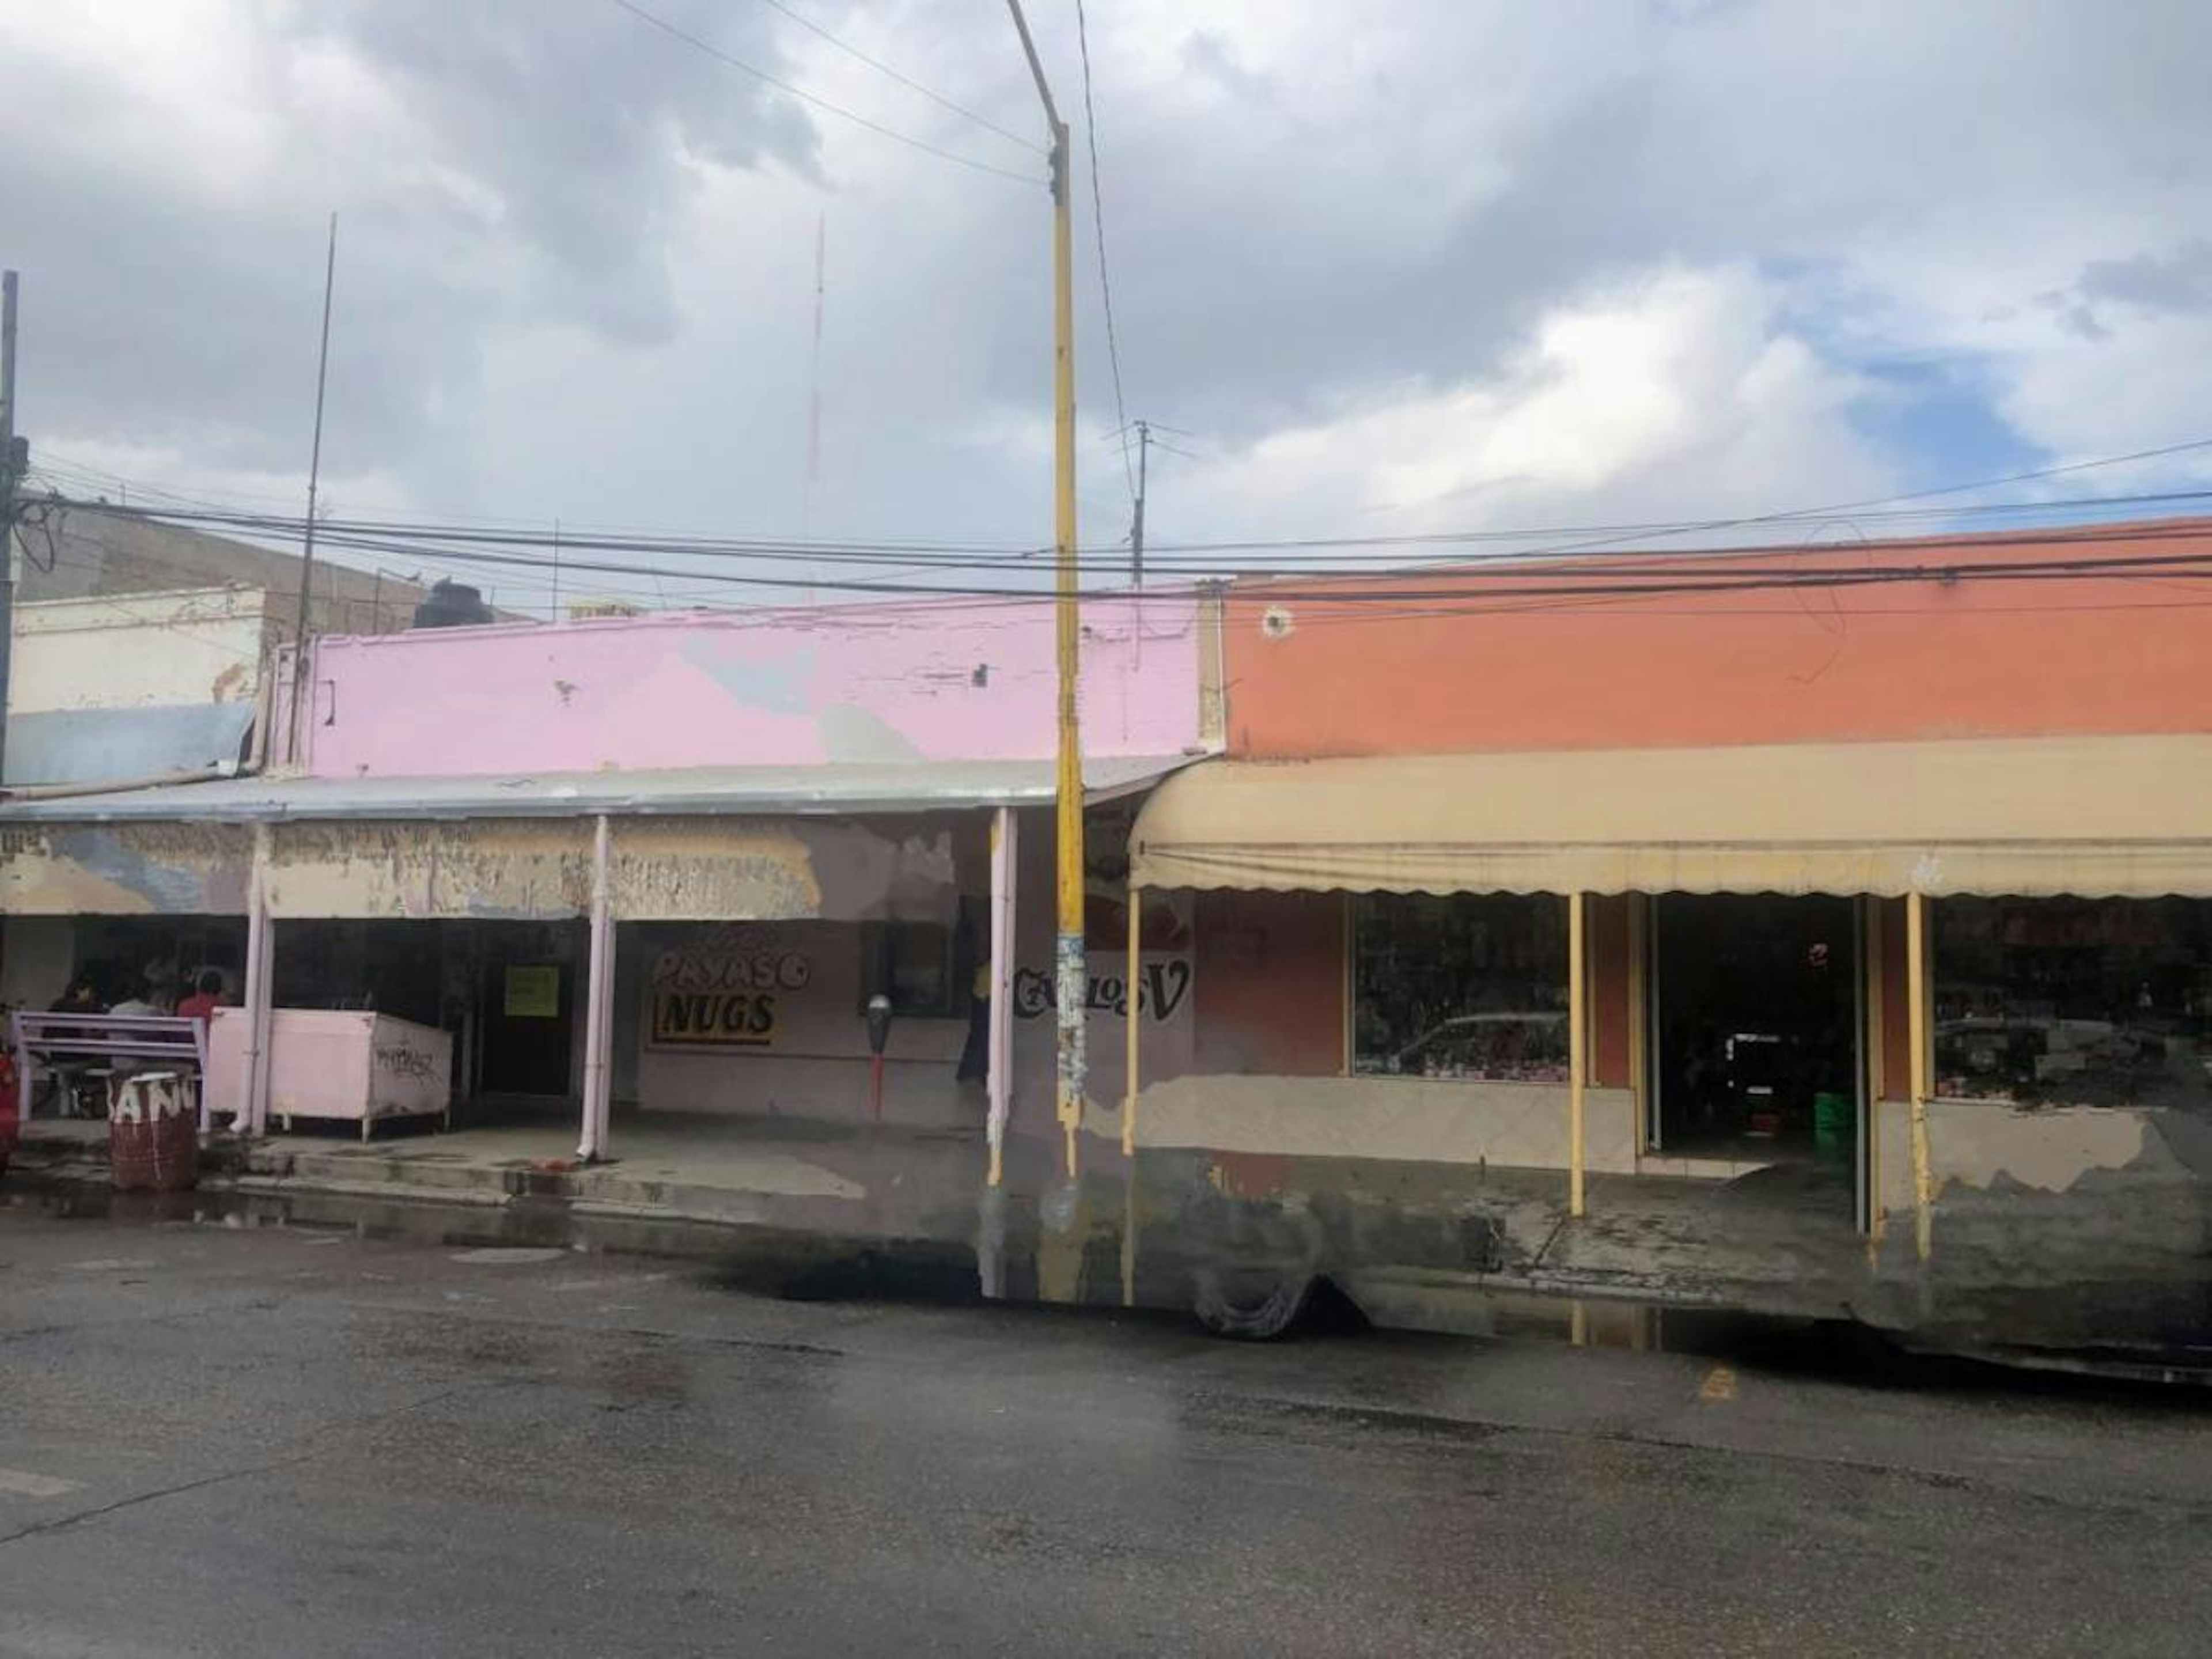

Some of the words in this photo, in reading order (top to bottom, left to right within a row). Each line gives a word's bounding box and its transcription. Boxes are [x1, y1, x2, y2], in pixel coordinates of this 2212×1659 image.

[651, 952, 811, 991] PAYASO
[1013, 967, 1149, 1018] CALOS
[1147, 959, 1190, 1020] V
[664, 994, 775, 1032] NUGS
